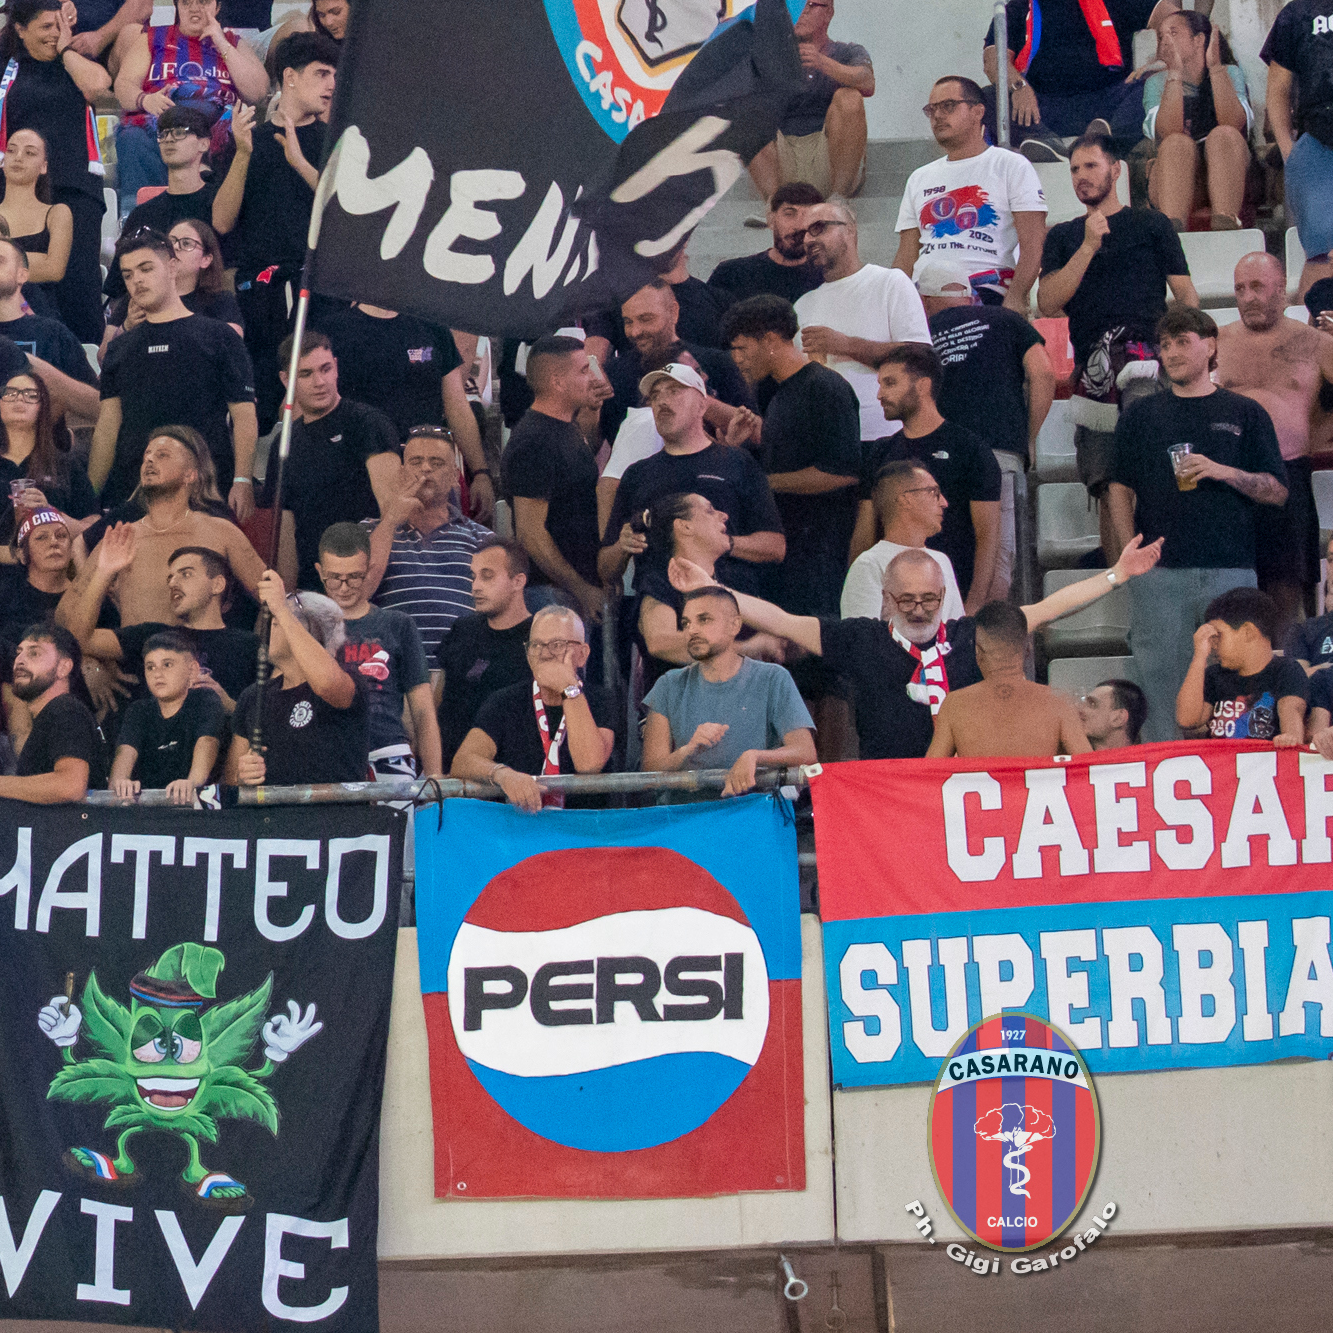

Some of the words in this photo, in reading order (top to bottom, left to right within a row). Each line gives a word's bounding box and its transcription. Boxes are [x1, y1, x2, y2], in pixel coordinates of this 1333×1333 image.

[923, 185, 946, 197] 1998
[1213, 700, 1246, 717] USP
[462, 951, 745, 1032] PERSI
